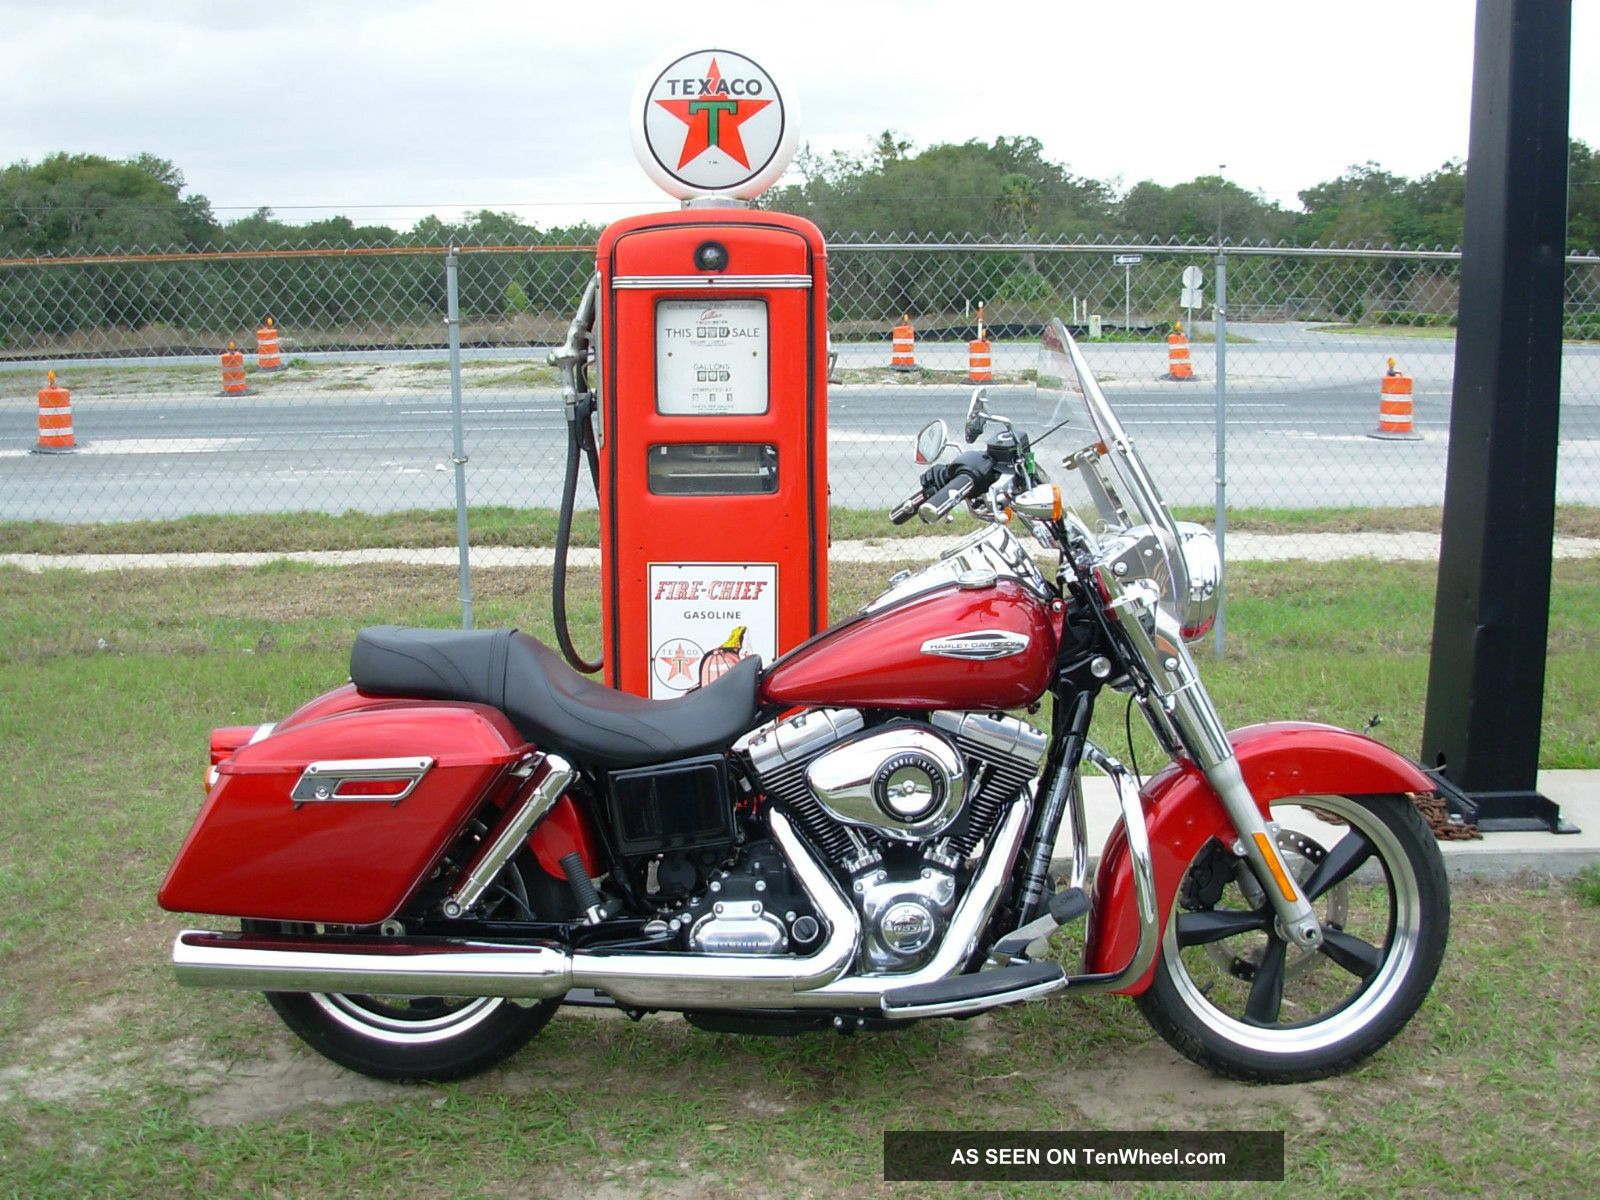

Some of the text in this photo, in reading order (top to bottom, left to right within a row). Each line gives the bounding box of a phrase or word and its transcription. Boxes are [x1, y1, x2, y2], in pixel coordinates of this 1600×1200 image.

[667, 78, 763, 96] TEXACO
[665, 328, 692, 338] THIS
[732, 328, 760, 338] SALE
[655, 580, 768, 601] FIRE-CHIEF
[683, 611, 742, 620] GASOLINE
